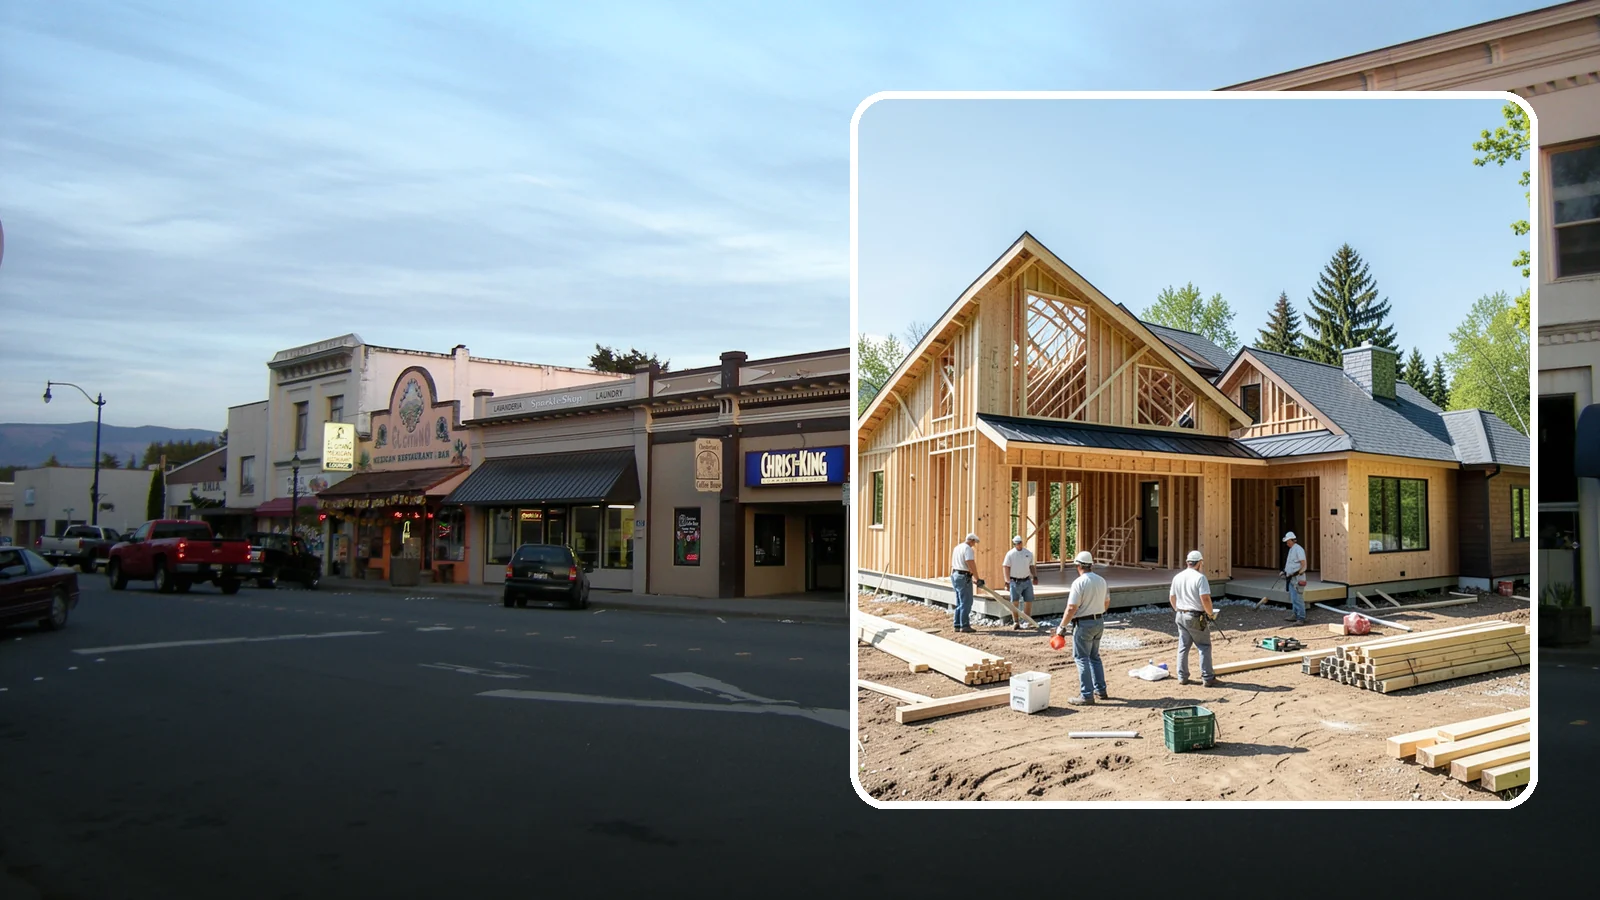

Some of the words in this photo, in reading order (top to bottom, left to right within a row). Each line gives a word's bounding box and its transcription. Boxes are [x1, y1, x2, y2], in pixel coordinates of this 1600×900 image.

[595, 389, 623, 400] LAUNDRY
[493, 402, 522, 412] LAVANDERIA
[531, 397, 561, 408] Sparkle
[562, 395, 582, 404] Shop
[373, 454, 396, 464] MEXICAN
[397, 451, 434, 462] RESTAURANT
[438, 450, 450, 459] BAR
[761, 452, 797, 478] CHRIST
[799, 450, 827, 476] KING
